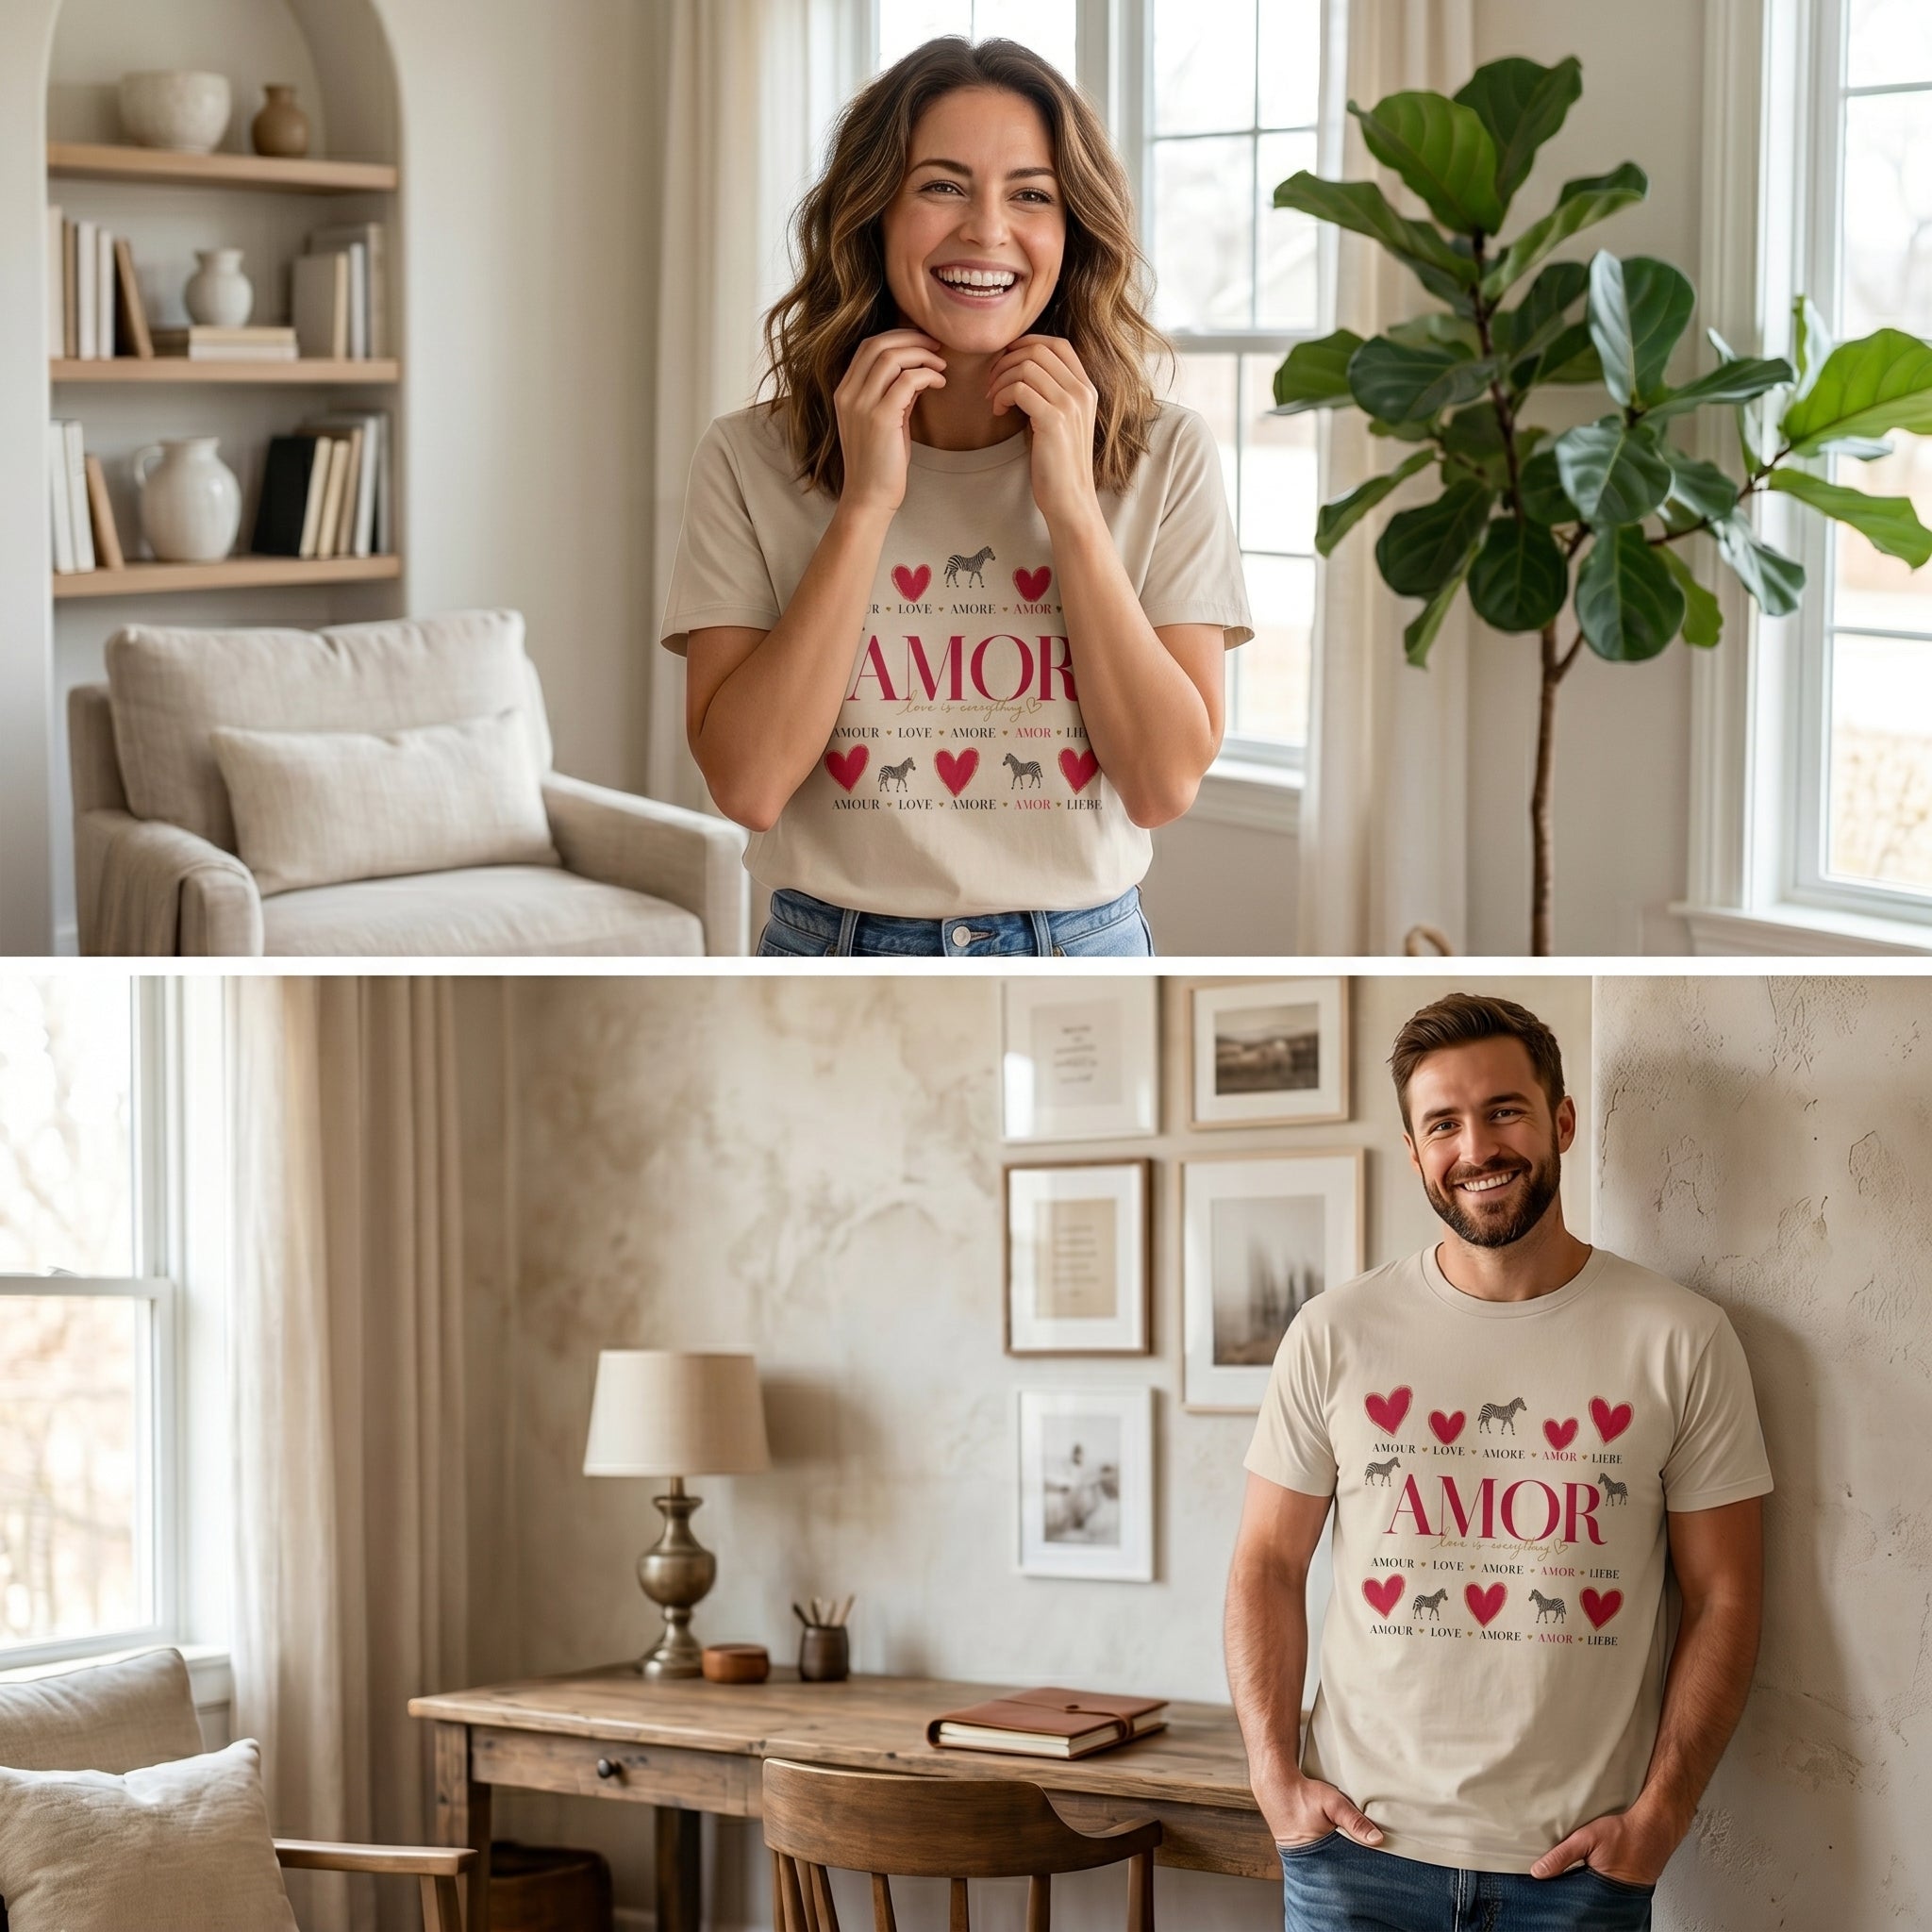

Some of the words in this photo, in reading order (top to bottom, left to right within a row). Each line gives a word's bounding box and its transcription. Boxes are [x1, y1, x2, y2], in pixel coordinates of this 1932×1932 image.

[898, 604, 932, 614] LOVE
[950, 604, 996, 614] AMORE
[1013, 604, 1052, 614] AMOR
[845, 634, 1078, 702] AMOR
[896, 690, 935, 715] love
[941, 703, 953, 714] is
[834, 726, 879, 739] AMOUR
[898, 727, 932, 739] LOVE
[950, 727, 996, 739] AMORE
[1015, 727, 1052, 739] AMOR
[832, 799, 880, 810] AMOUR
[899, 799, 933, 810] LOVE
[950, 799, 996, 810] AMORE
[1014, 799, 1051, 810] AMOR
[1066, 799, 1102, 810] LIEBE
[1372, 1443, 1416, 1455] AMOUR
[1433, 1445, 1465, 1457] LOVE
[1541, 1451, 1577, 1462] AMOR
[1382, 1474, 1607, 1545] AMOR
[1371, 1557, 1415, 1569] AMOUR
[1433, 1560, 1464, 1572] LOVE
[1481, 1563, 1524, 1574] AMORE
[1541, 1566, 1575, 1577] AMOR
[1590, 1568, 1620, 1579] LIEBE
[1370, 1624, 1413, 1636] AMOUR
[1430, 1627, 1462, 1639] LOVE
[1479, 1630, 1522, 1641] AMORE
[1538, 1633, 1574, 1644] AMOR
[1587, 1635, 1618, 1646] LIEBE
